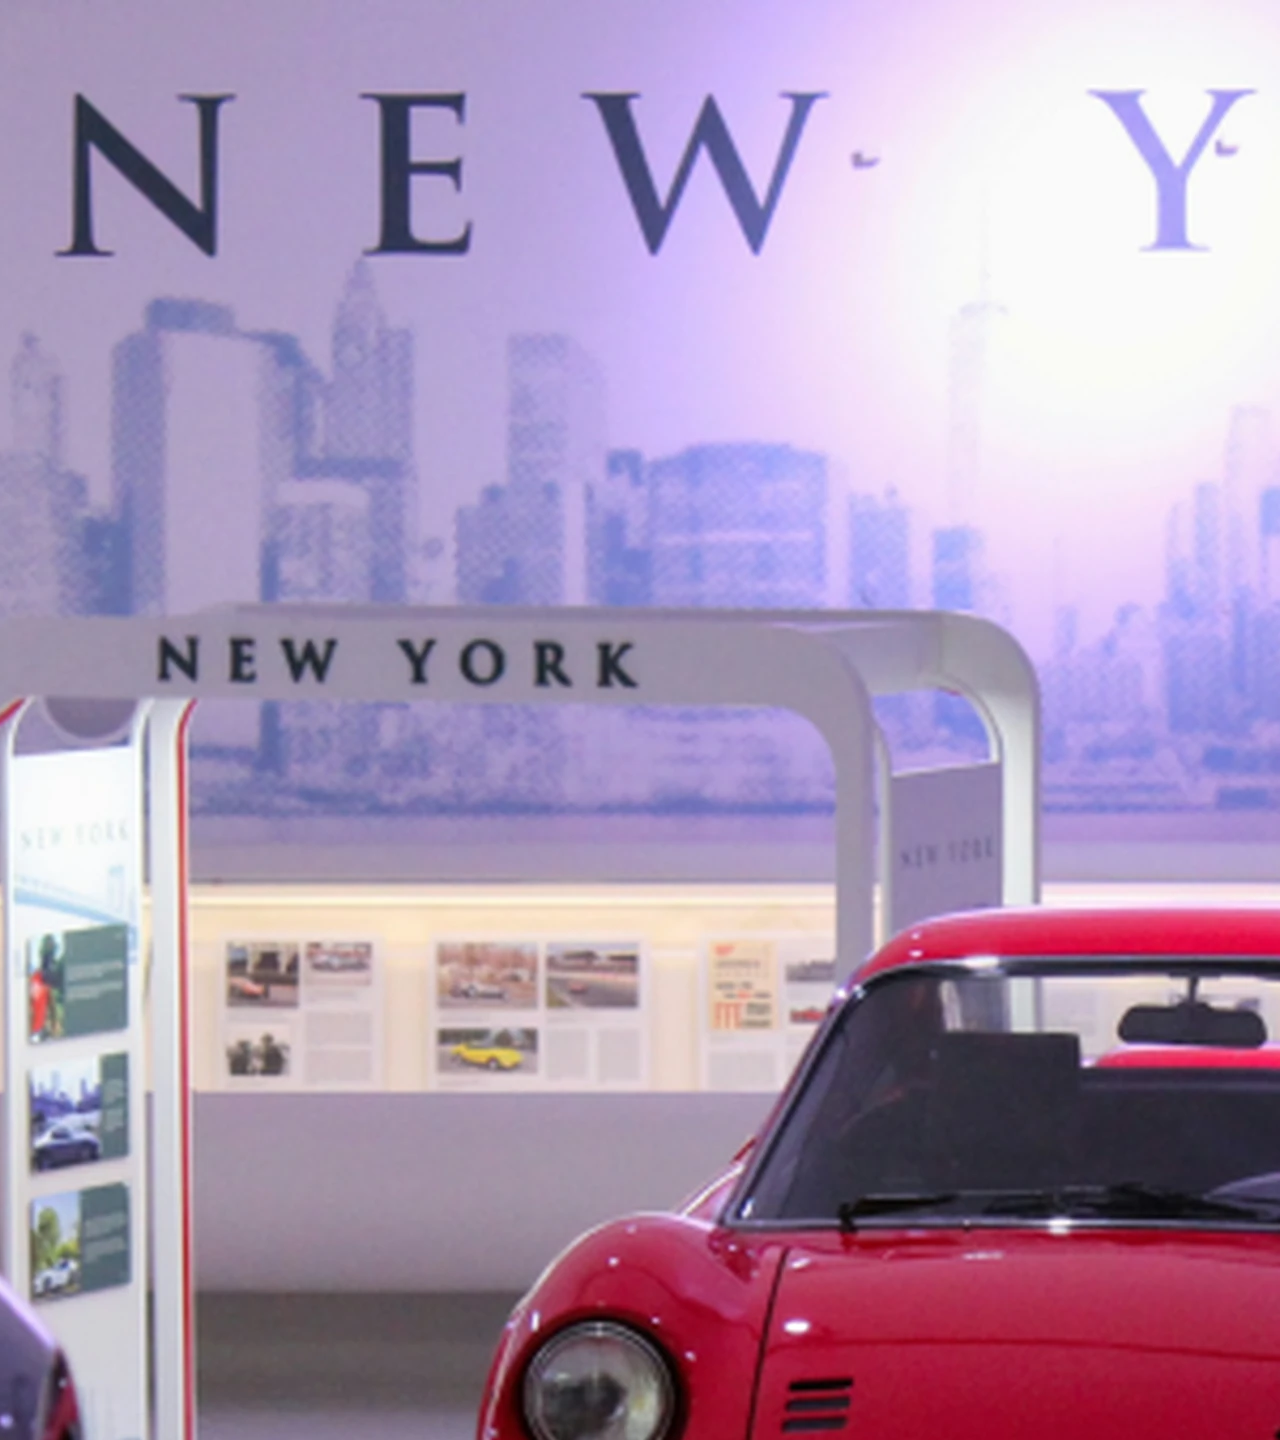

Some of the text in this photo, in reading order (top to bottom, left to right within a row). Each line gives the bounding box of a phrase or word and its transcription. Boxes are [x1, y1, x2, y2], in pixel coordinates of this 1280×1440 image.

[55, 92, 830, 258] NEW
[157, 635, 639, 689] NEW YORK
